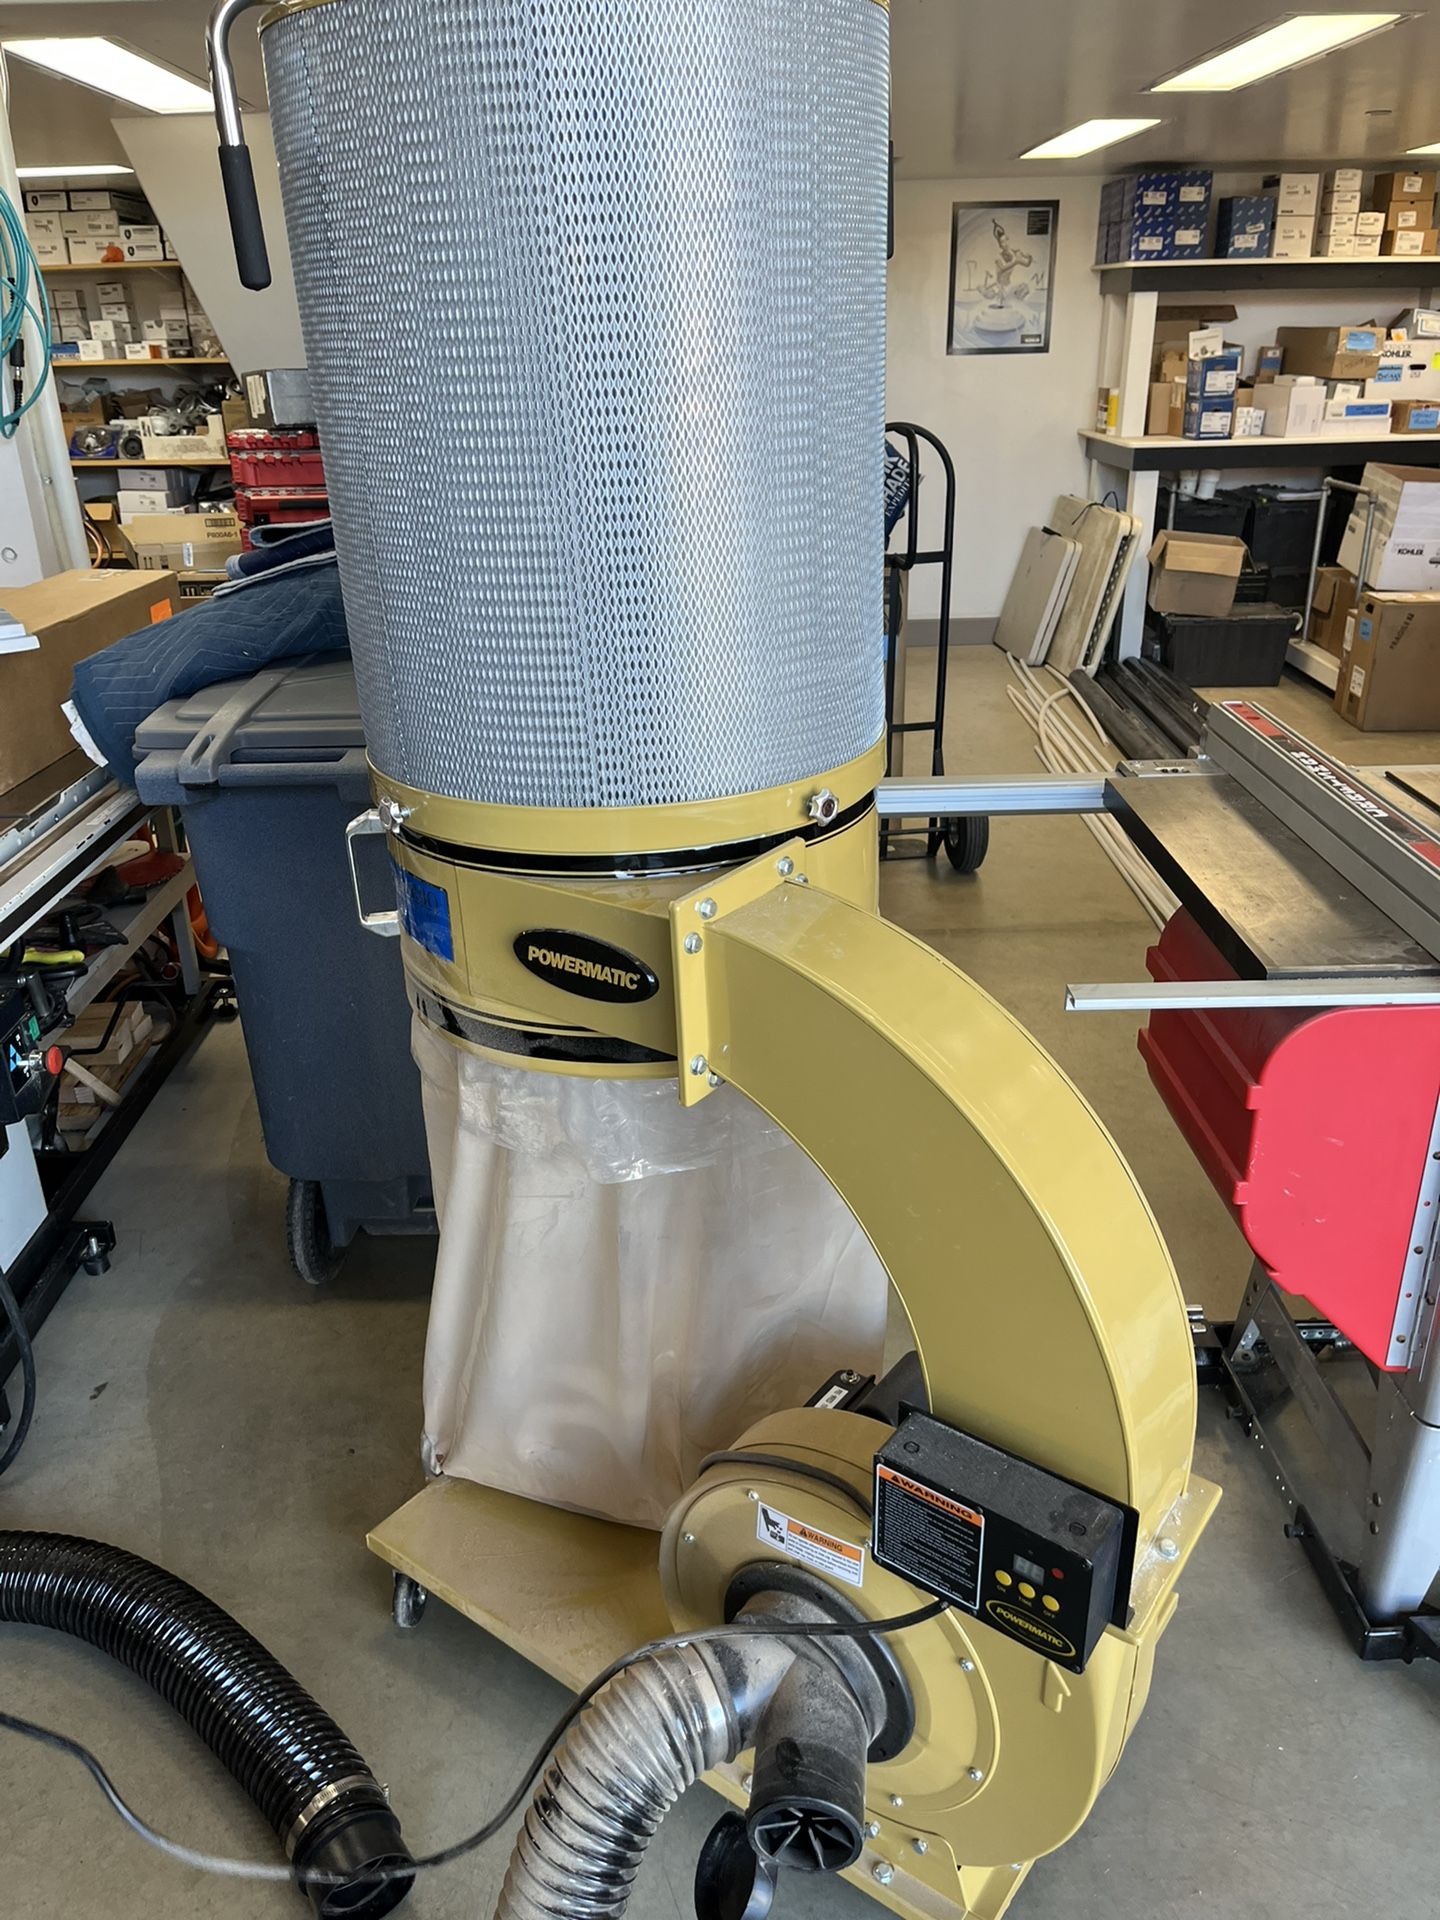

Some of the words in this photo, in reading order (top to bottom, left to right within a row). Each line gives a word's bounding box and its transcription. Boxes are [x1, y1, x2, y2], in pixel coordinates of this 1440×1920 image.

[884, 459, 910, 507] HADE
[527, 945, 639, 990] POWERMATIC
[900, 1479, 973, 1520] WARNING
[807, 1531, 843, 1552] WARNING
[996, 1606, 1064, 1648] POWERMATIC
